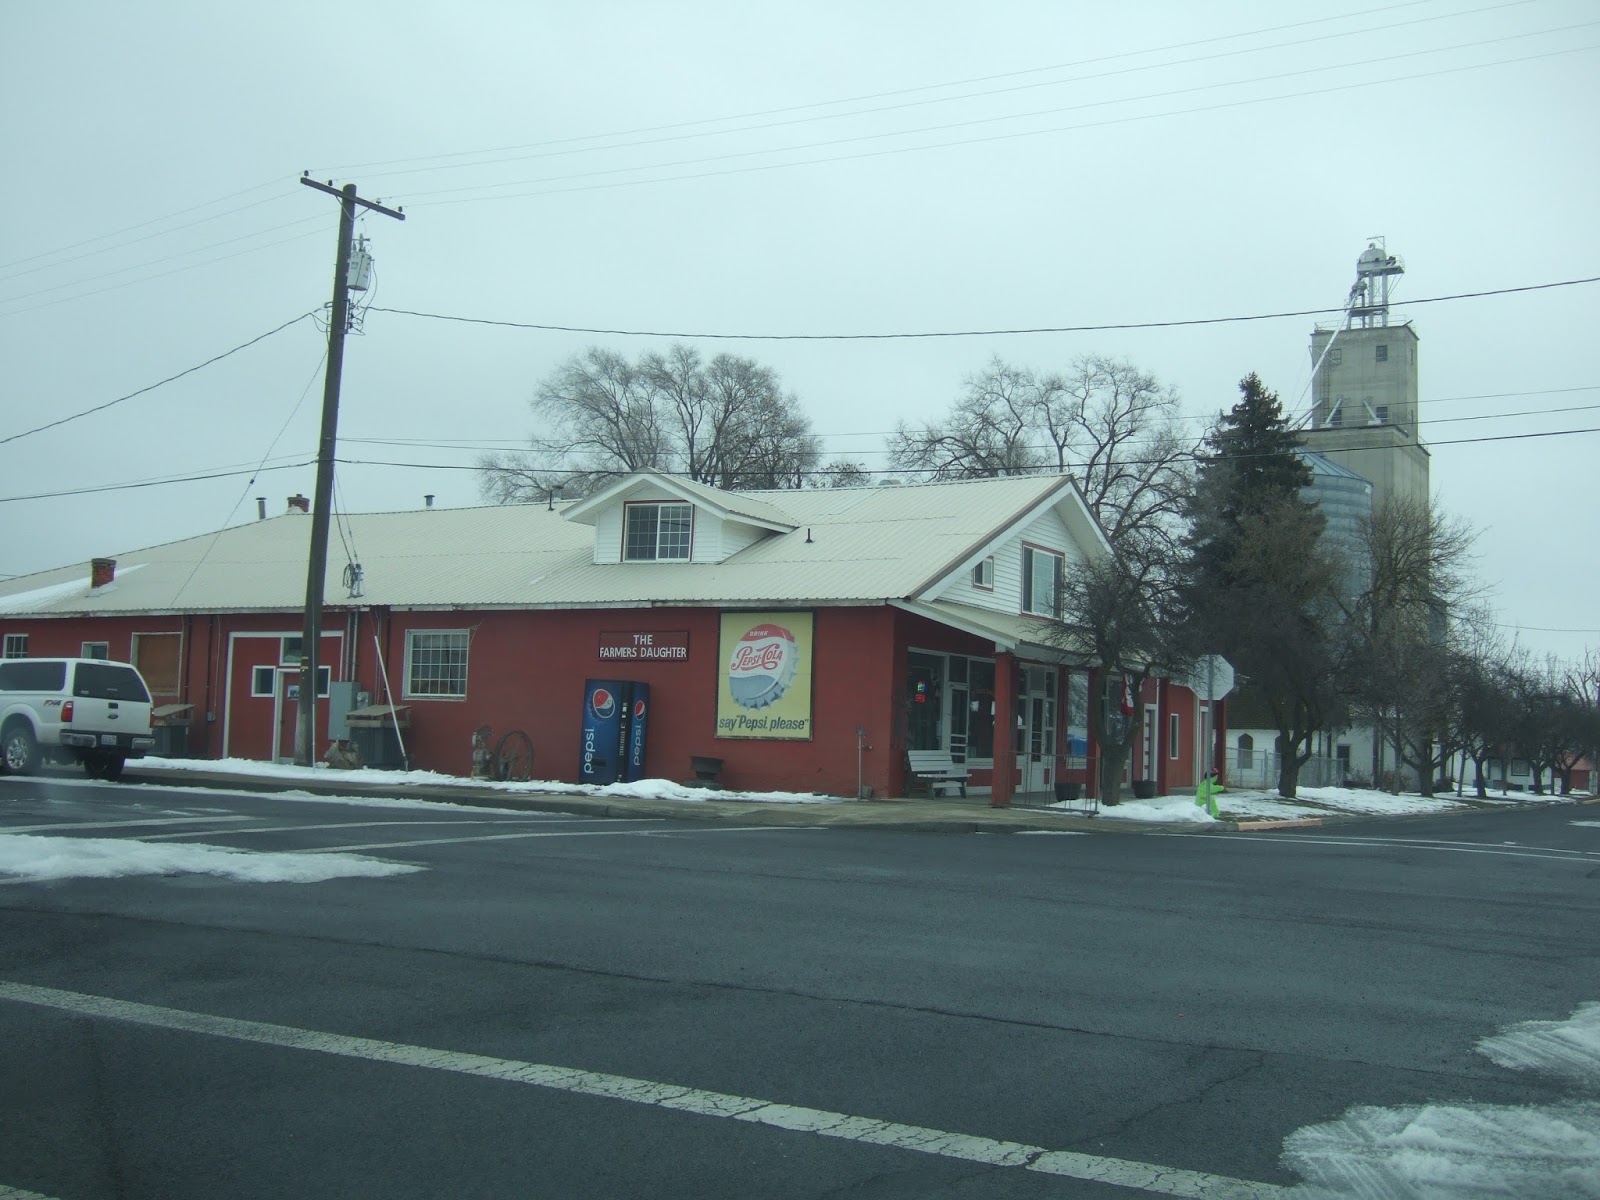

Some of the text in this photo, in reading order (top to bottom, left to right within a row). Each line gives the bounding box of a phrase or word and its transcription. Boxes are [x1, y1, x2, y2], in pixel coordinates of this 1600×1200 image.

[633, 634, 653, 645] THE
[600, 647, 687, 658] FARMERS DAUGHTER
[719, 718, 737, 731] say
[583, 727, 596, 774] pepsi
[633, 724, 642, 766] pepsi
